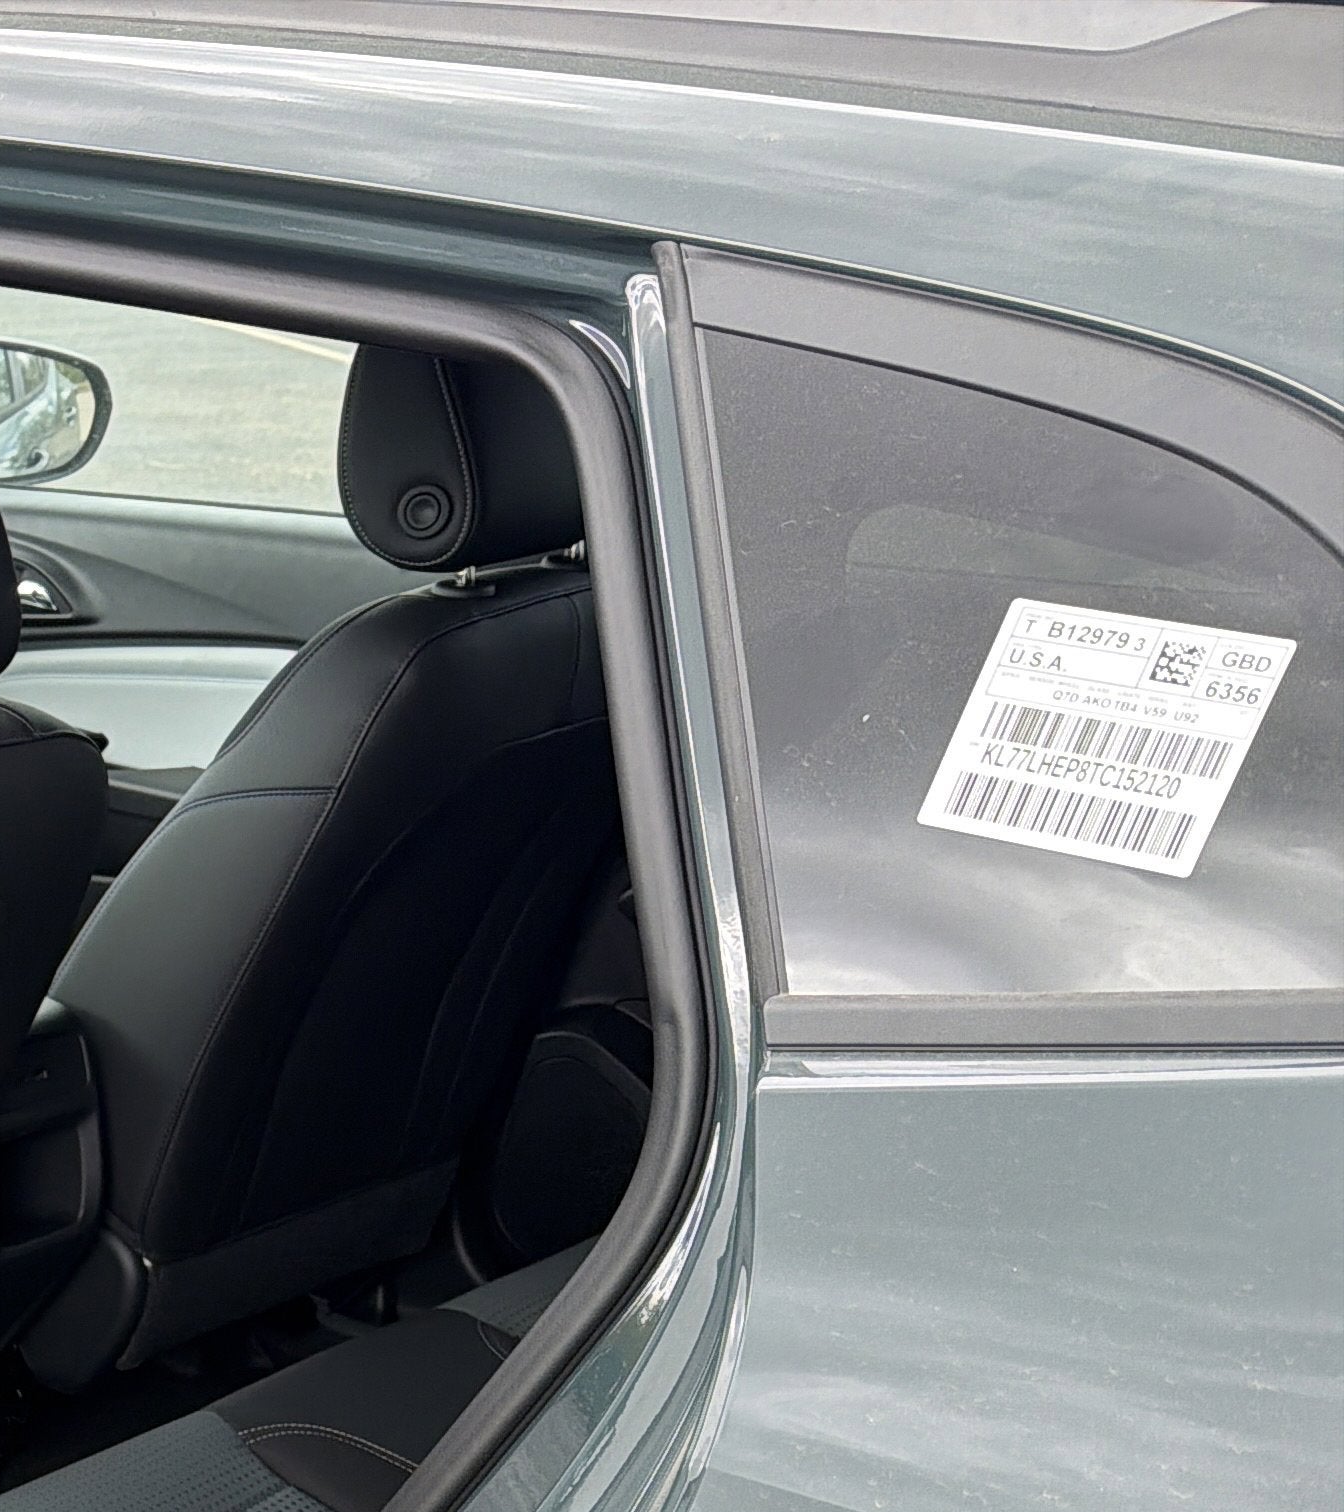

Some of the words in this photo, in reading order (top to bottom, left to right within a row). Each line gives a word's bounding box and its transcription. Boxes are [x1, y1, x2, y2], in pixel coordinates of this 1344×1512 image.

[1025, 619, 1037, 633] T
[1047, 621, 1131, 649] B12979
[1134, 637, 1147, 652] 3
[1009, 648, 1068, 673] U.S.A.
[1221, 651, 1272, 672] GBD
[1205, 680, 1263, 705] 6356
[1144, 705, 1168, 718] V59
[1174, 711, 1200, 724] U92
[980, 743, 1183, 799] KL77LHEP8TC152120
